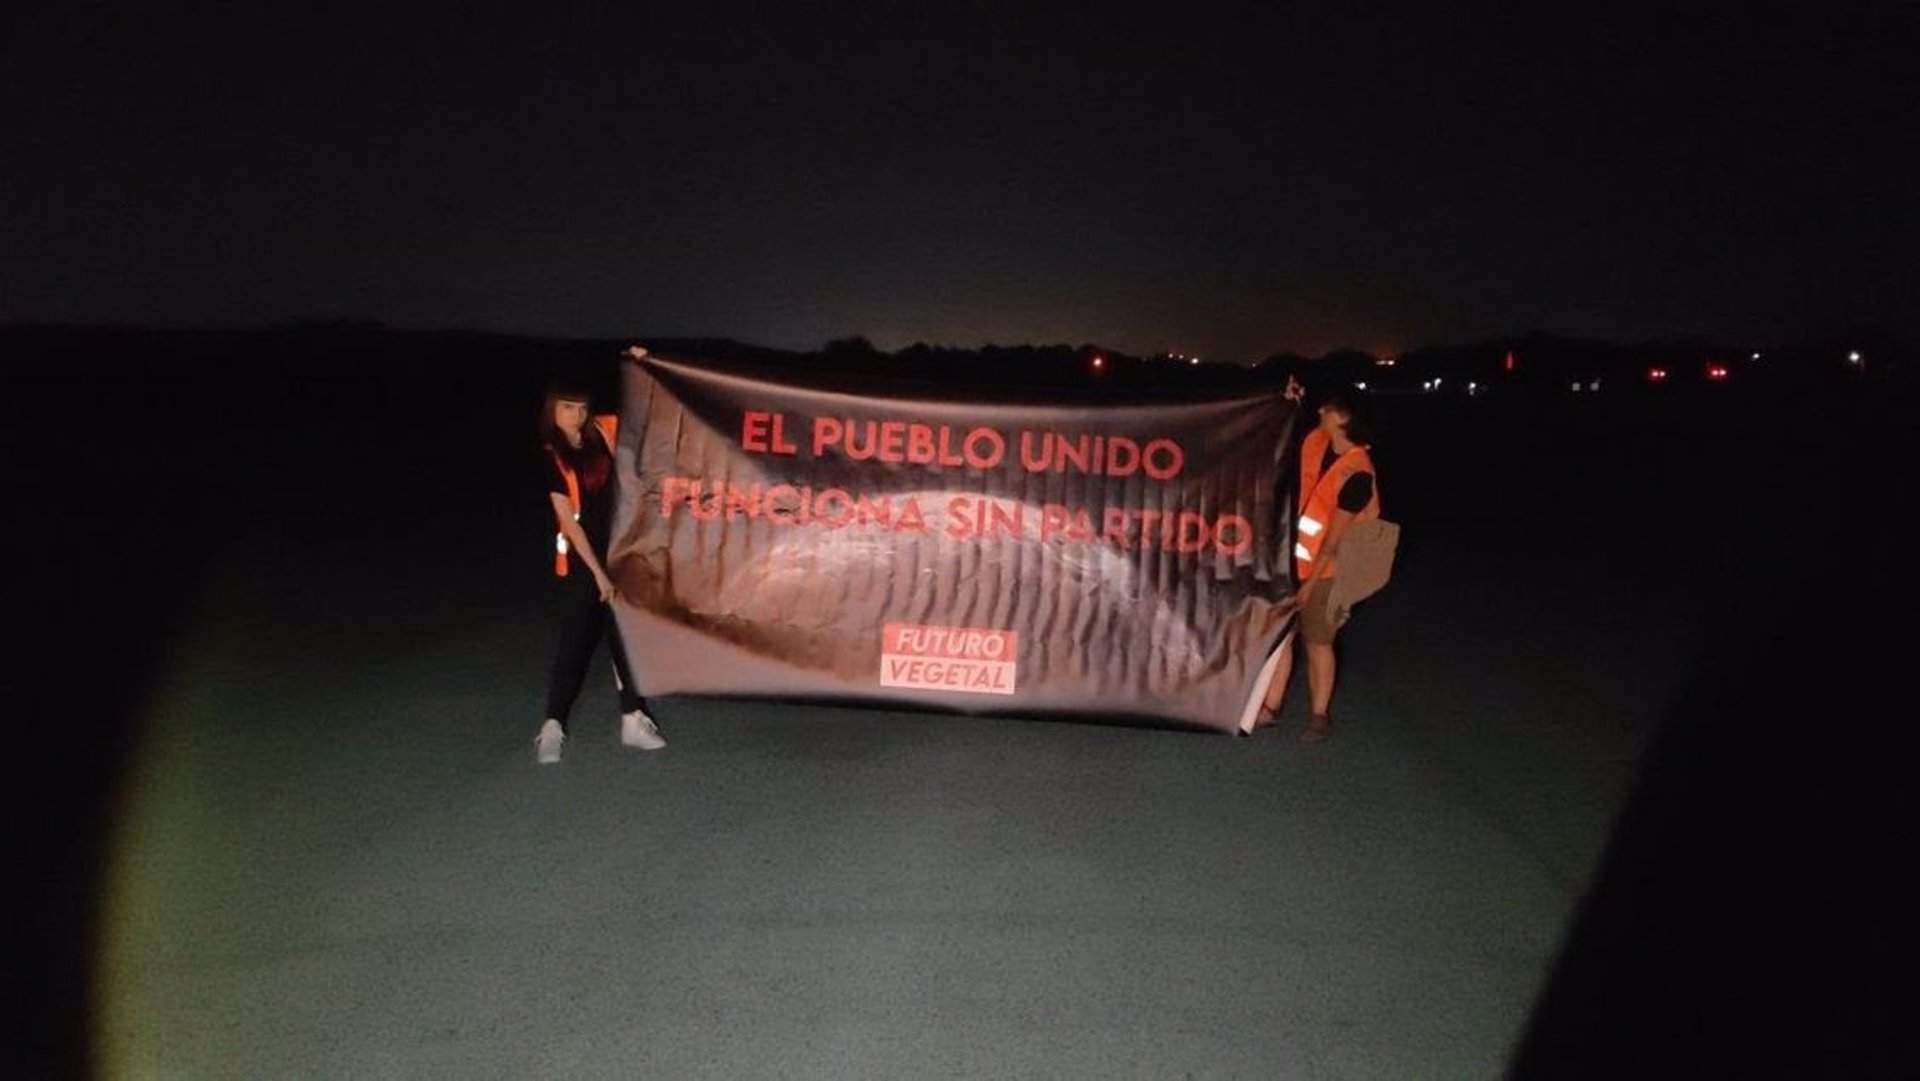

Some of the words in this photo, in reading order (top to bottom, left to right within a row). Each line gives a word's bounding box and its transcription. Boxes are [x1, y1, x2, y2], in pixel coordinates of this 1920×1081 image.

[741, 411, 797, 455] EL
[813, 417, 1005, 469] PUEBLO
[1020, 431, 1184, 480] UNIDO
[661, 477, 928, 534] FUNCIONA
[945, 497, 1022, 541] SIN
[1040, 506, 1253, 556] PARTIDO
[896, 628, 1005, 657] FUTURO
[891, 659, 1006, 689] VEGETAL
